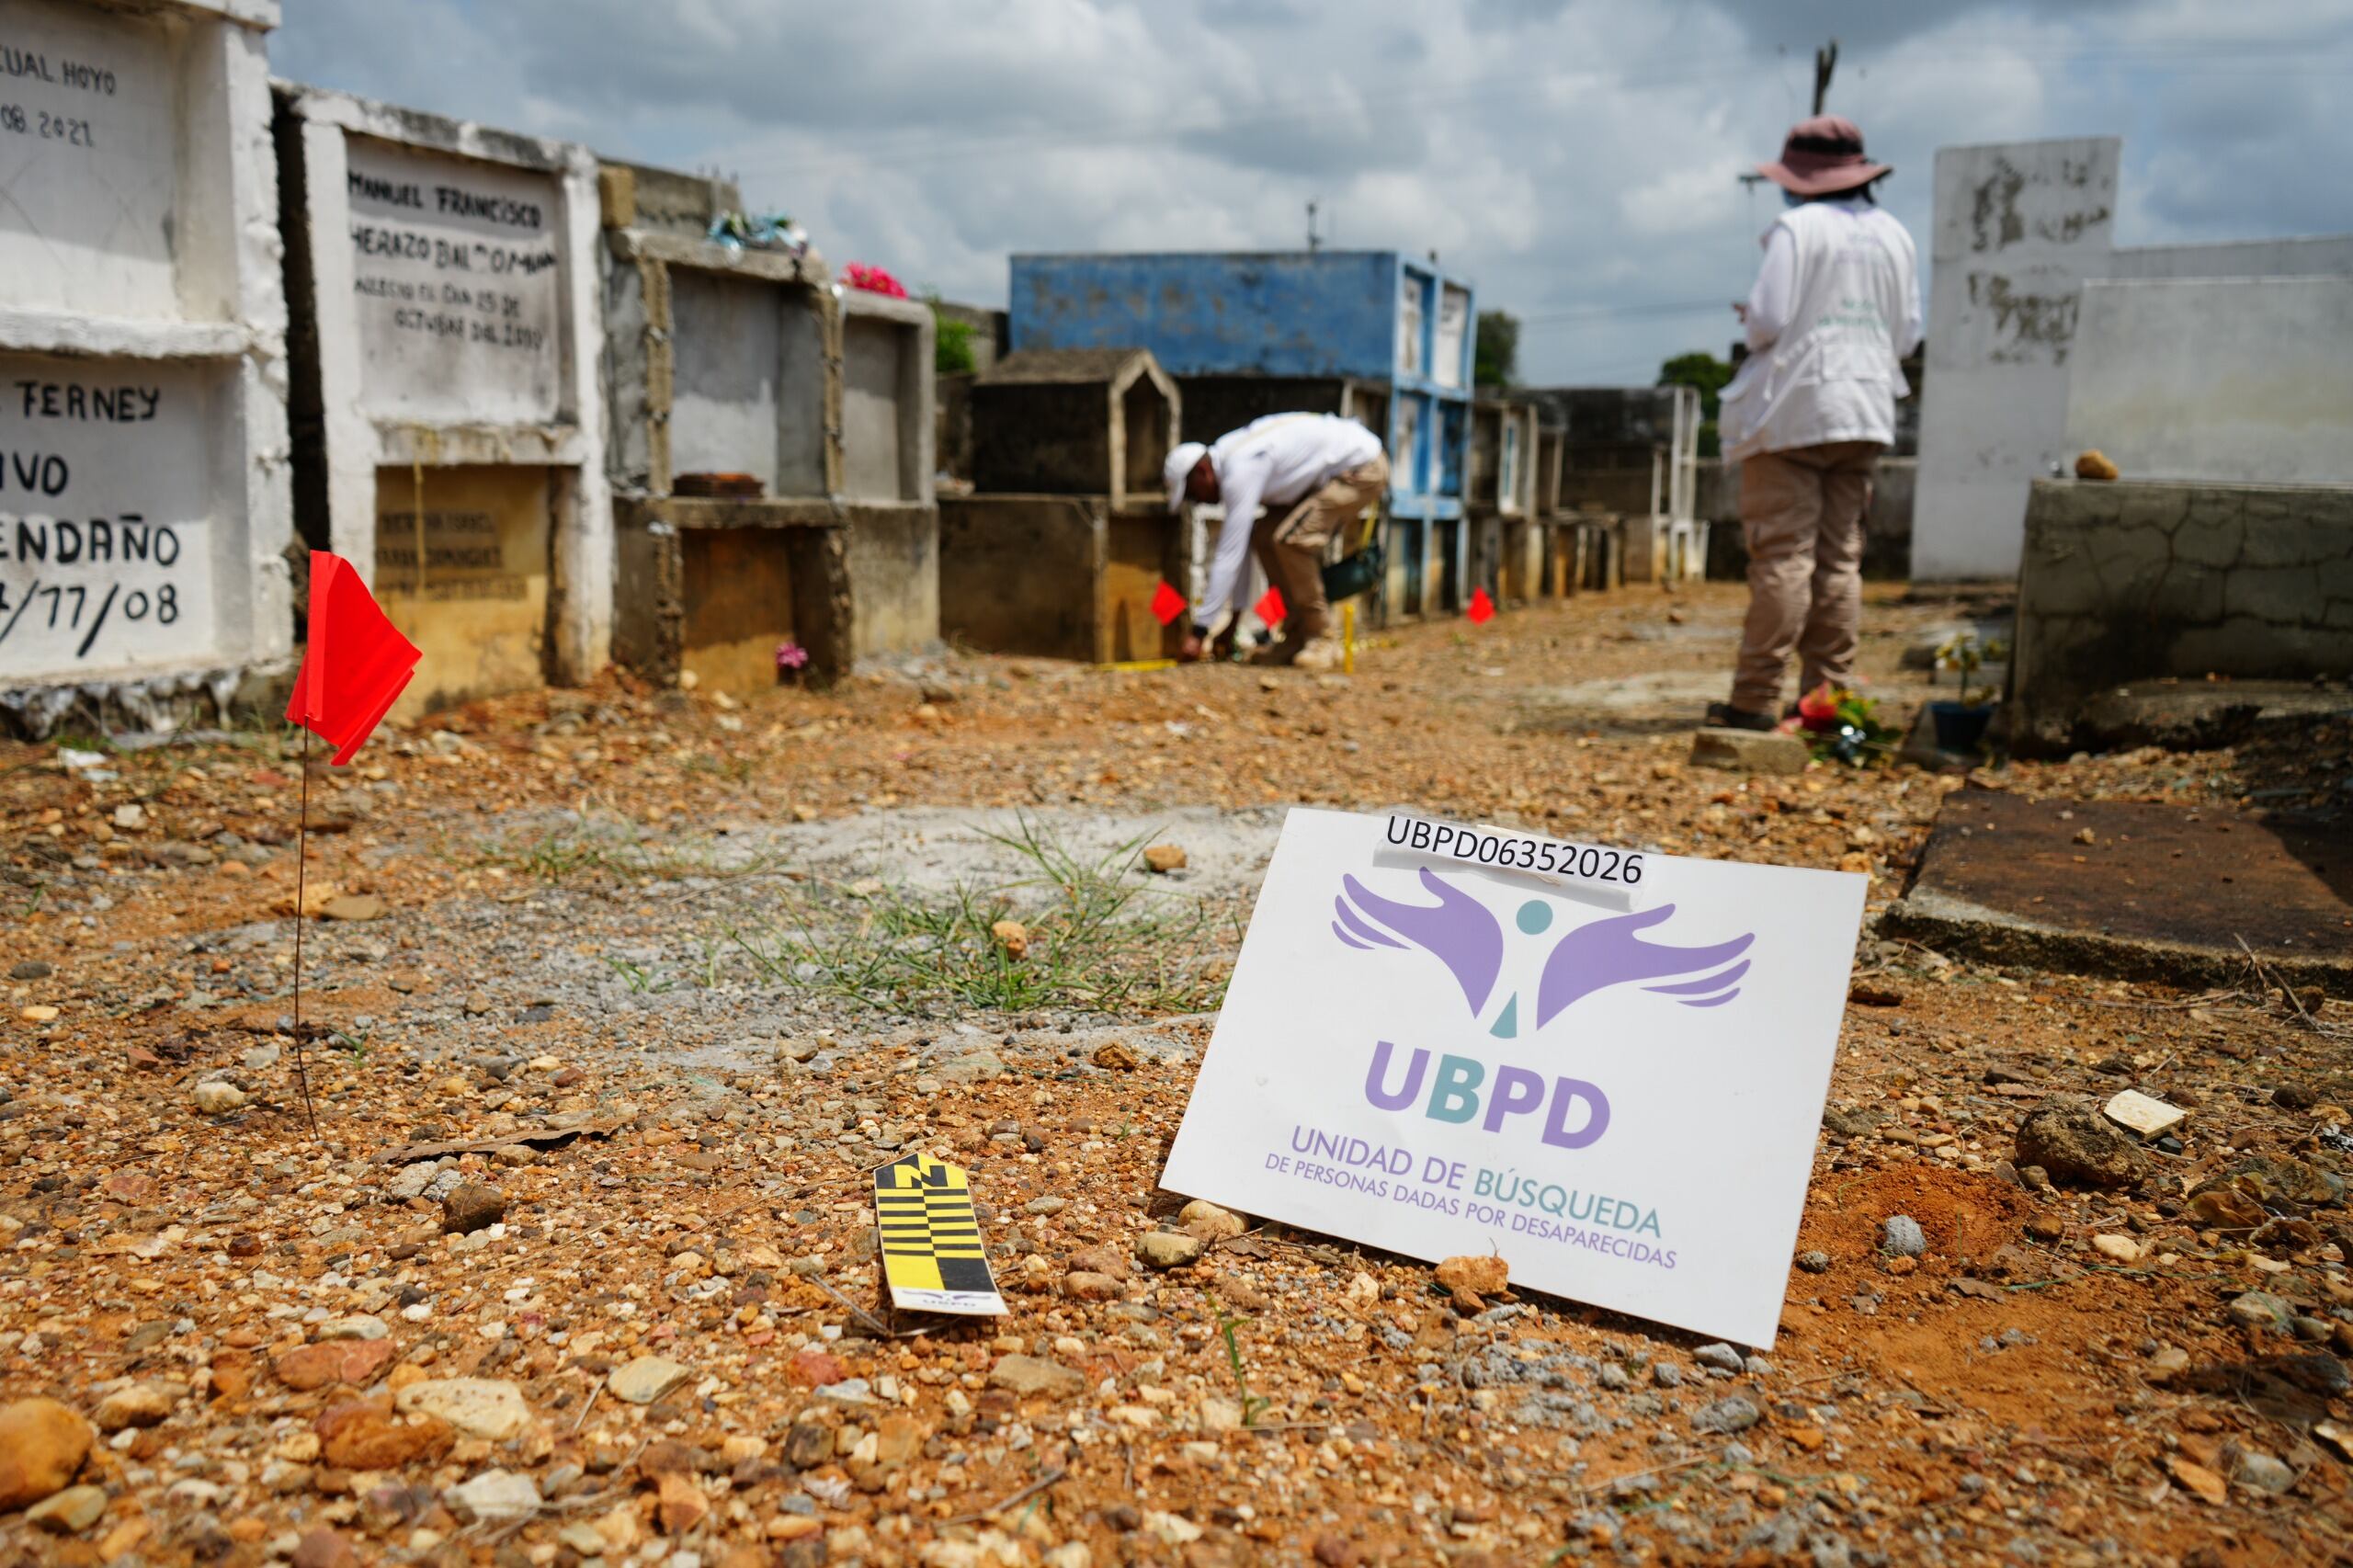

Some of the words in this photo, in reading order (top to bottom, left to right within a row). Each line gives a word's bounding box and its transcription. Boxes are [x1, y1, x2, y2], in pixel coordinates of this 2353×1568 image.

[62, 59, 117, 97] HOYO
[1385, 814, 1645, 885] UBPD06352026
[1365, 1040, 1611, 1150] UBPD
[1265, 1153, 1291, 1175] DE
[1293, 1160, 1390, 1199] PERSONAS
[1393, 1184, 1461, 1217] DADAS
[1465, 1201, 1507, 1229] POR
[1511, 1213, 1678, 1270] DESAPARECIDAS
[1291, 1125, 1414, 1176] UNIDAD
[1422, 1156, 1467, 1191] DE
[1473, 1167, 1662, 1240] BÚSQUEDA
